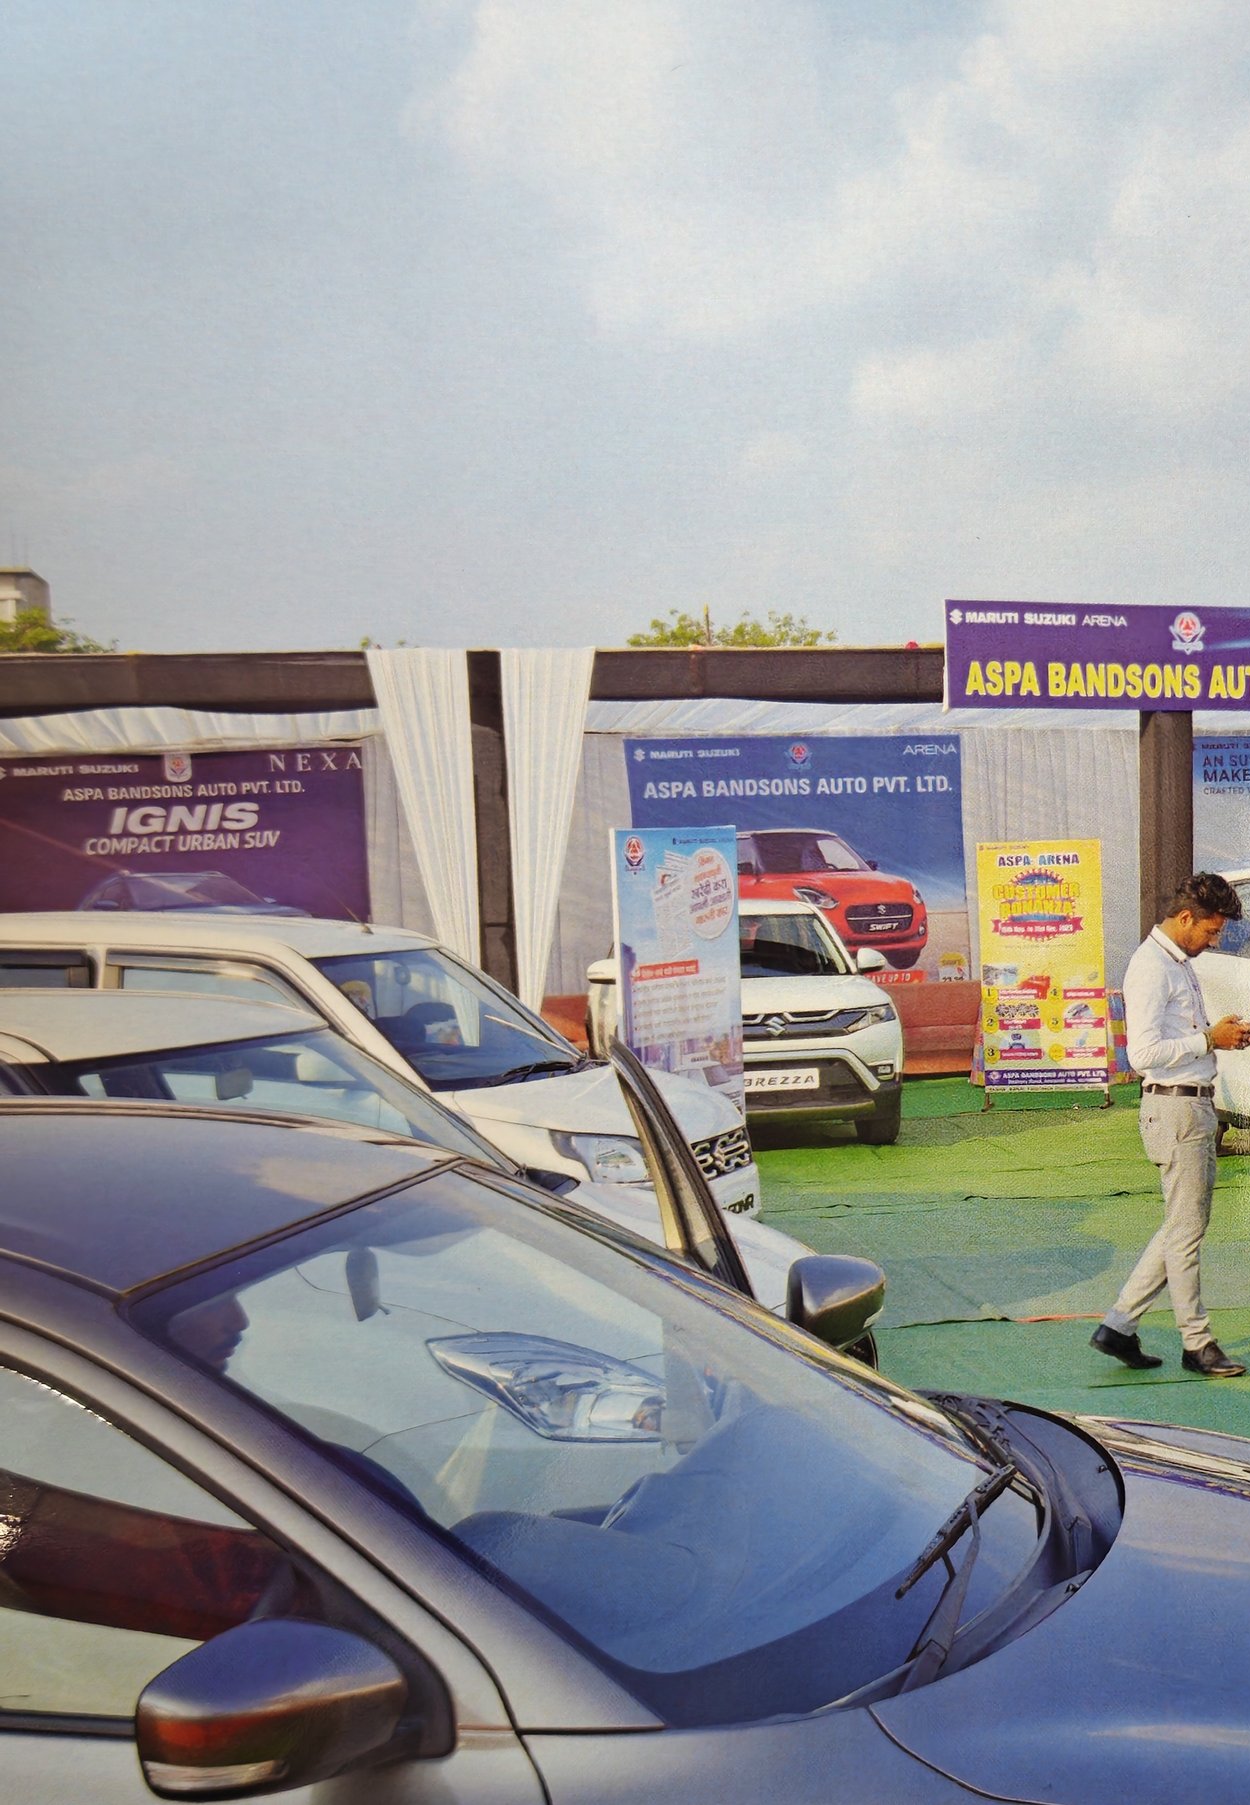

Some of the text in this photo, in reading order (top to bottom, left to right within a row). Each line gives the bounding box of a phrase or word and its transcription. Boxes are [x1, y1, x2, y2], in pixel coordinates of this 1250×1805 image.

[965, 611, 1128, 627] MARUTI SUZUKI ARENA
[965, 660, 1041, 697] ASPA
[1047, 661, 1201, 699] BANDSONS
[648, 743, 958, 760] MARUTI SUZUKI ARENA
[268, 751, 363, 773] NEXA
[1202, 755, 1224, 768] AN
[12, 763, 140, 777] MARUTI SUZUKI
[1202, 768, 1250, 783] MAKE
[63, 779, 306, 802] ASPA BANDSONS AUTO PVT. LTD.
[643, 775, 953, 800] ASPA BANDSONS AUTO PVT. LTD.
[1203, 786, 1245, 795] CRAFTED
[109, 800, 261, 836] IGNIS
[86, 830, 281, 856] COMPACT URBAN SUV
[997, 852, 1080, 867] ASPA ARENA
[992, 882, 1081, 900] CUSTOMER
[868, 922, 899, 932] SWIFT
[744, 1074, 815, 1088] BREZZA
